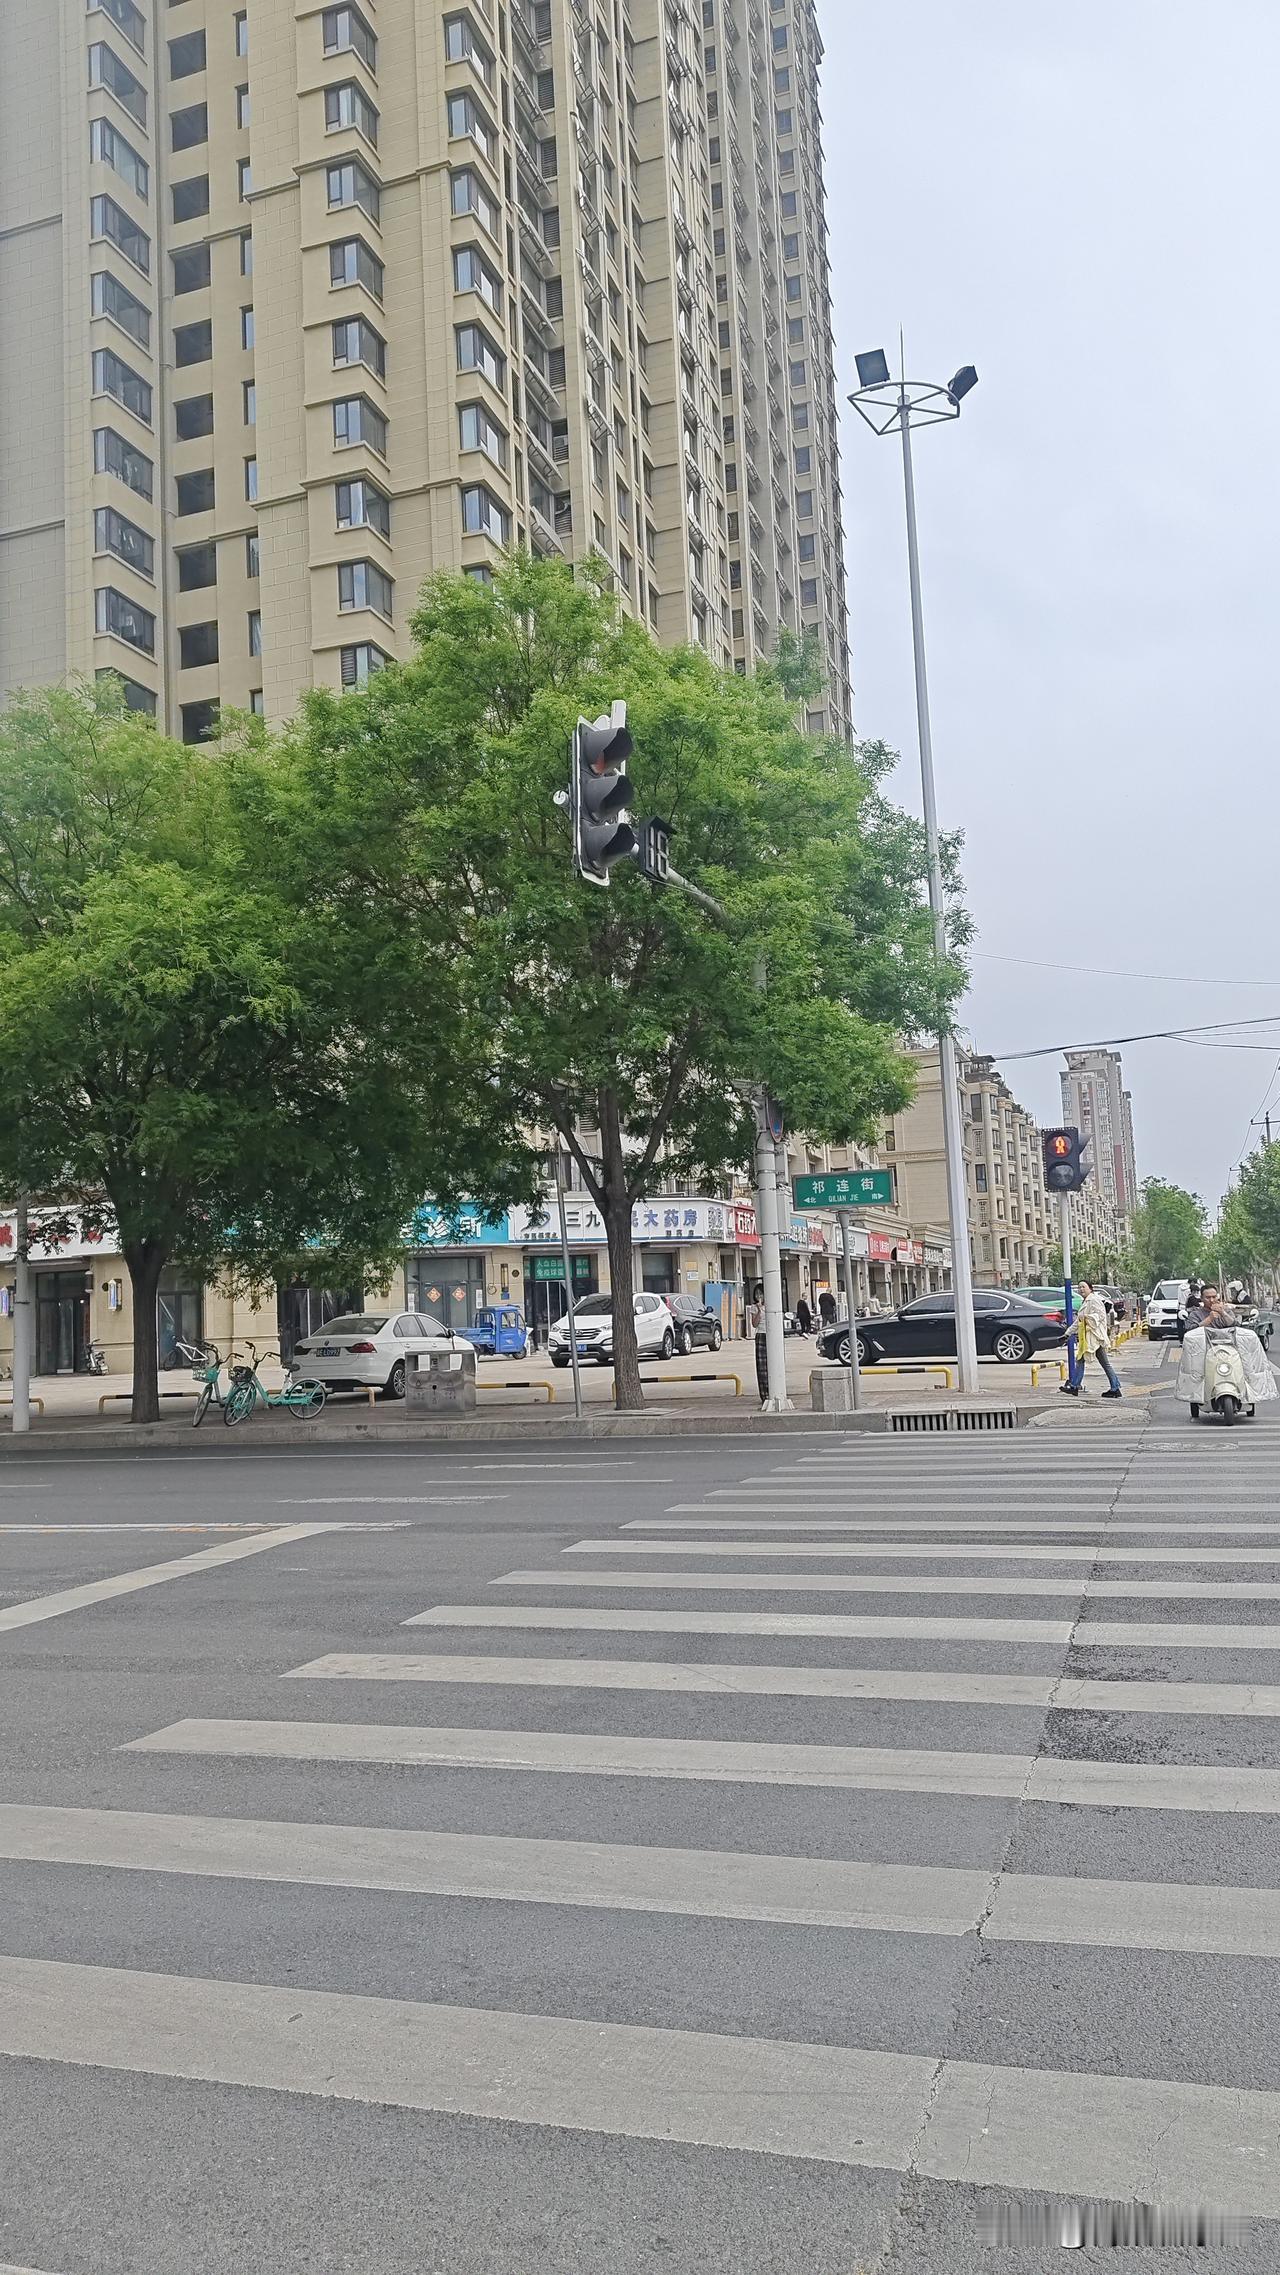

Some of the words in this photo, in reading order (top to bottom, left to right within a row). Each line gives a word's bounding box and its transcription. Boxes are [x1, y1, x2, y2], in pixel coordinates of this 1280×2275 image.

[812, 1177, 874, 1194] 祁连街
[828, 1194, 847, 1203] QILIAN
[849, 1193, 860, 1201] JIE
